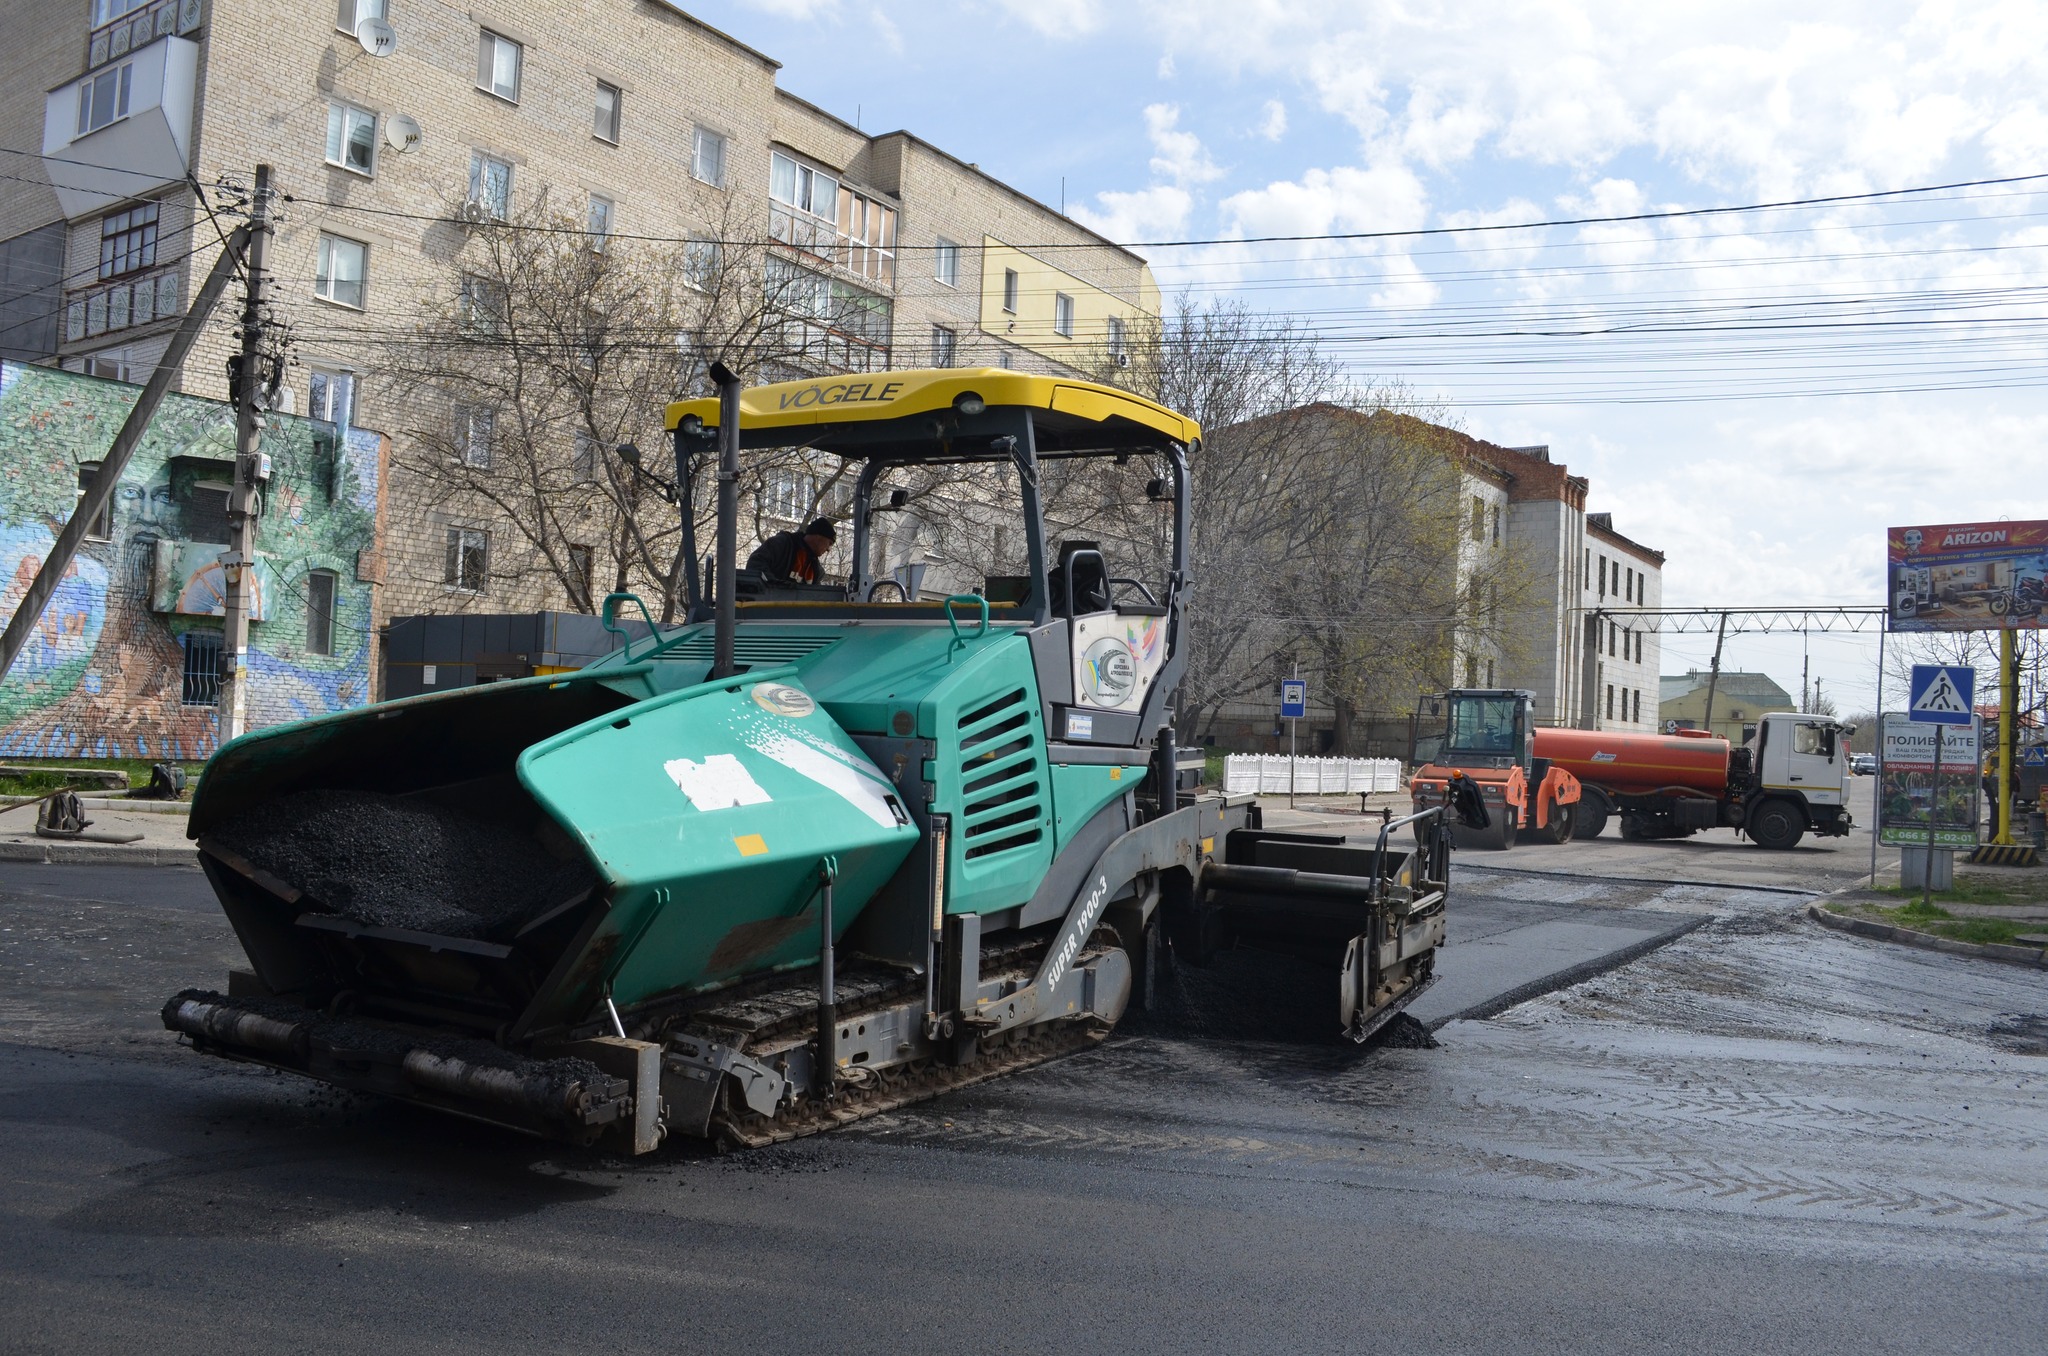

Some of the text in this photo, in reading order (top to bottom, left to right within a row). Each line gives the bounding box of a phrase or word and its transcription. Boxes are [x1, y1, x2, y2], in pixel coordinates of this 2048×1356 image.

[778, 382, 904, 410] VÖGELE
[1942, 530, 2007, 547] ARIZON
[1898, 831, 1972, 842] 066 53-02-01
[1047, 875, 1108, 993] SUPER 1900-3
